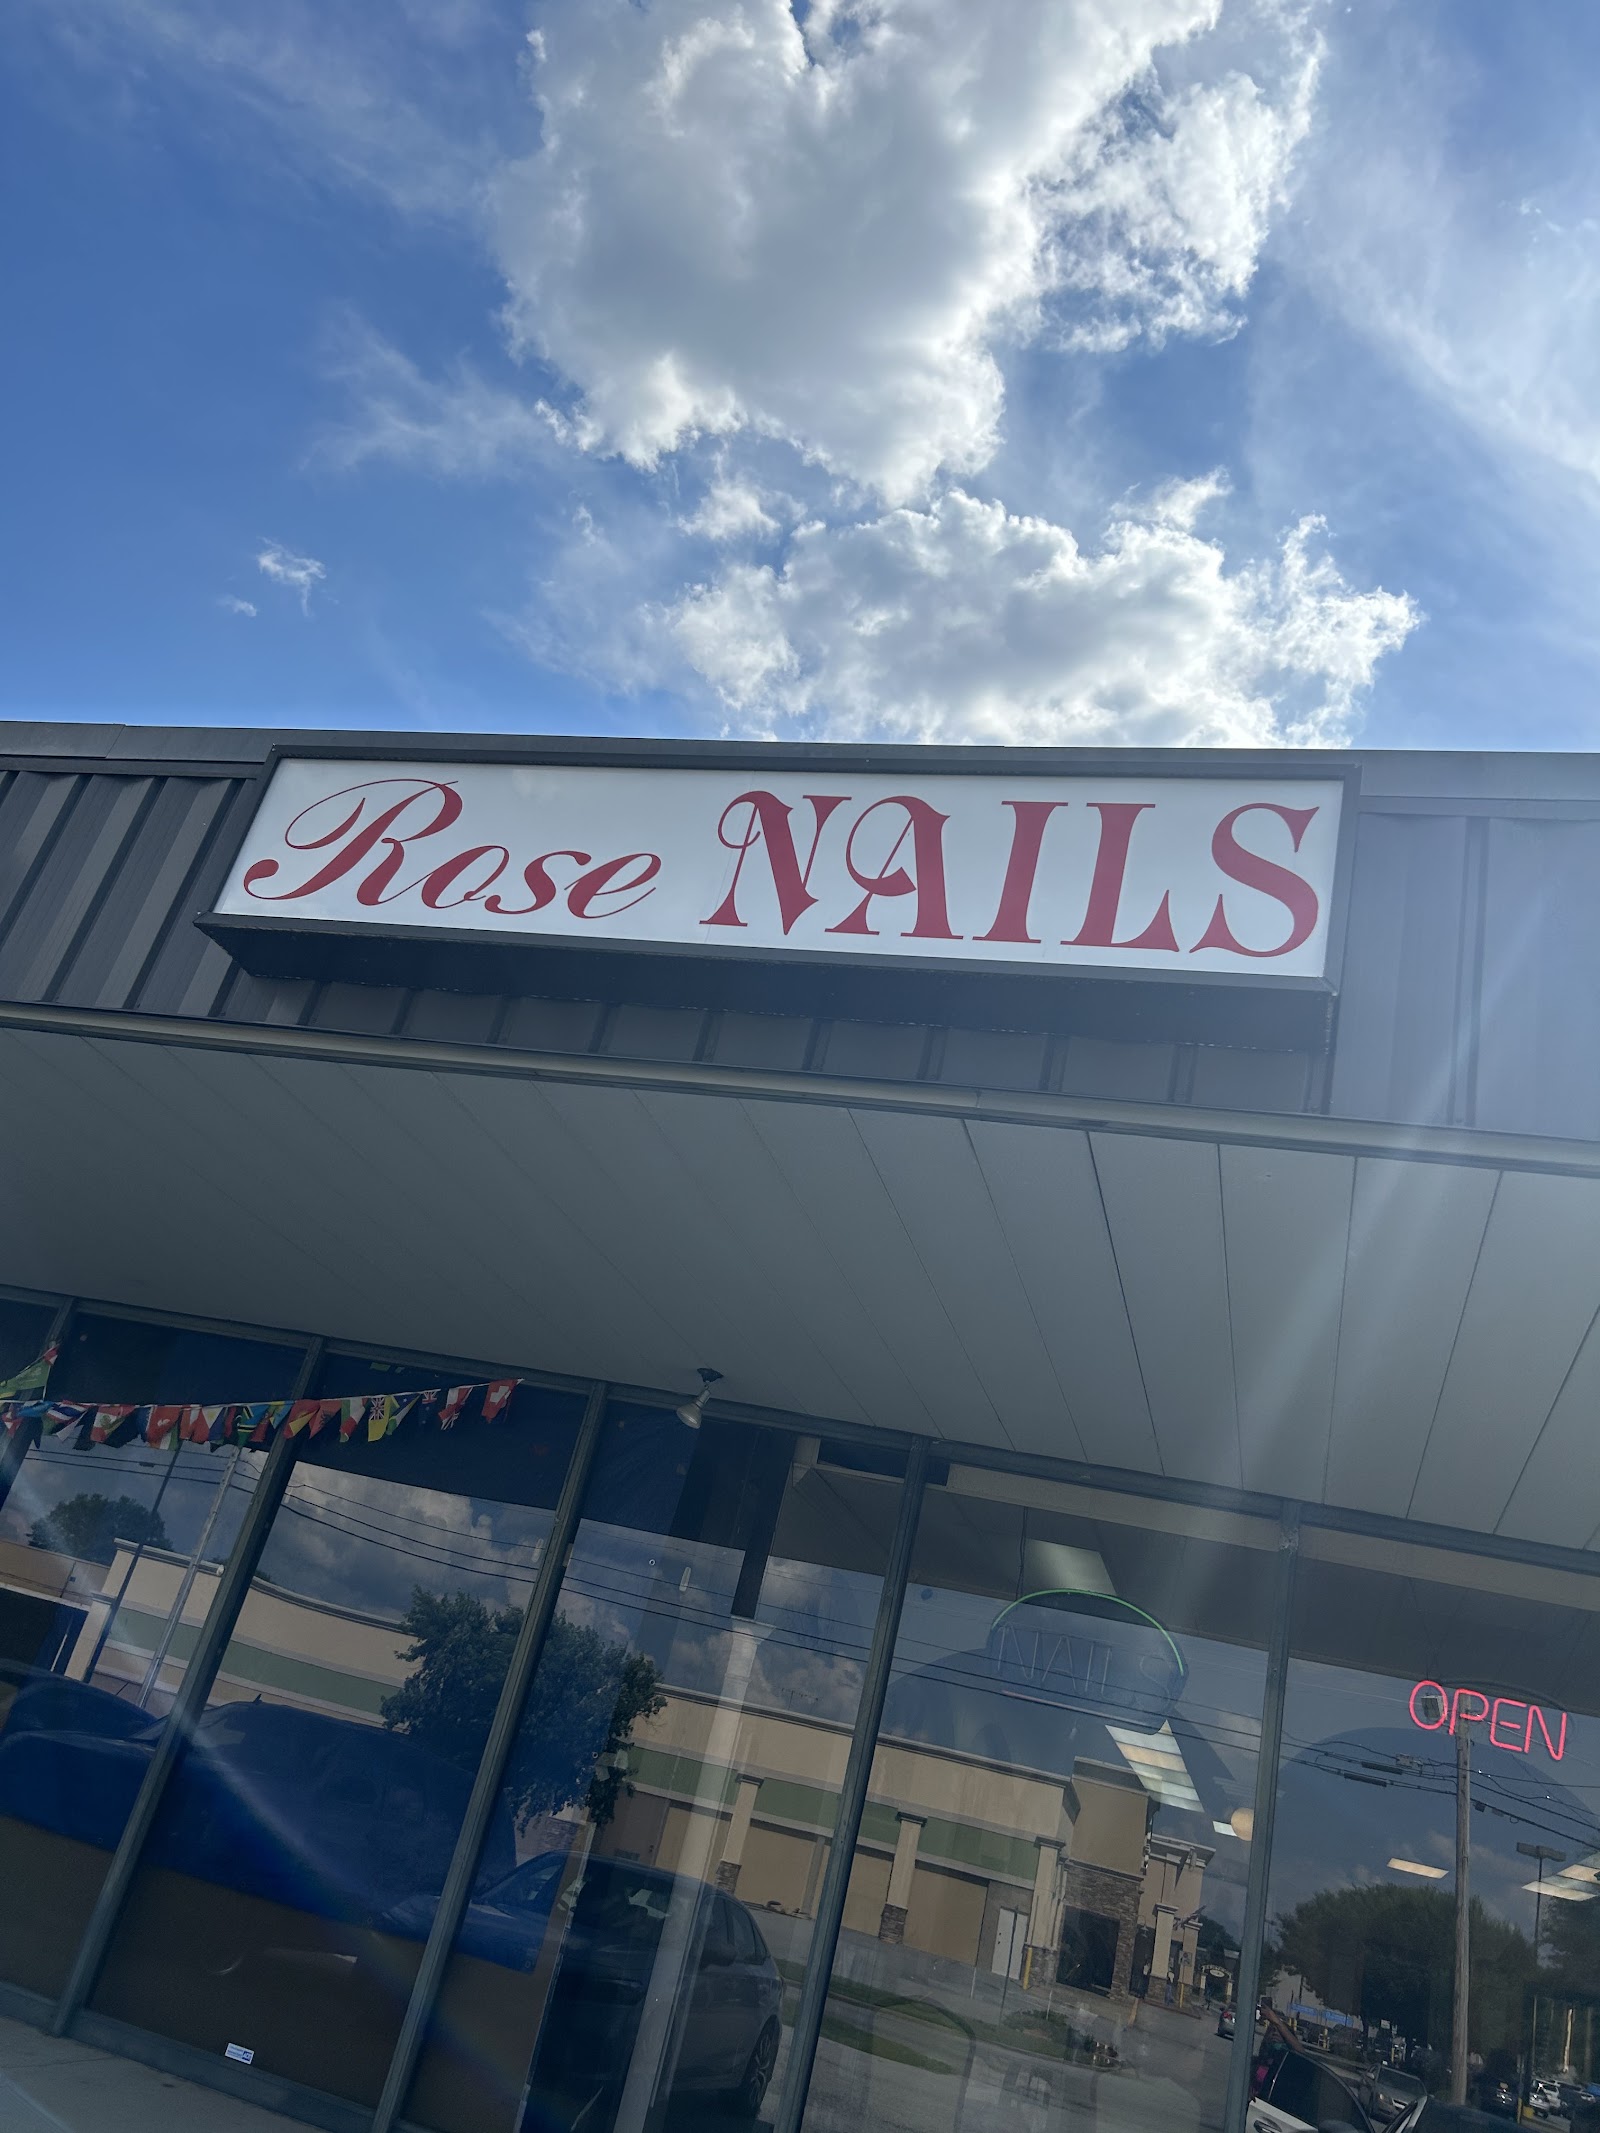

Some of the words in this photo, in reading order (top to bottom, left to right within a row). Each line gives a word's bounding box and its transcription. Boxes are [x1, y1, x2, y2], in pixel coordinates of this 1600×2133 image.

[243, 778, 662, 919] Rose
[699, 789, 1320, 957] NAILS
[1408, 1679, 1567, 1761] OPEN
